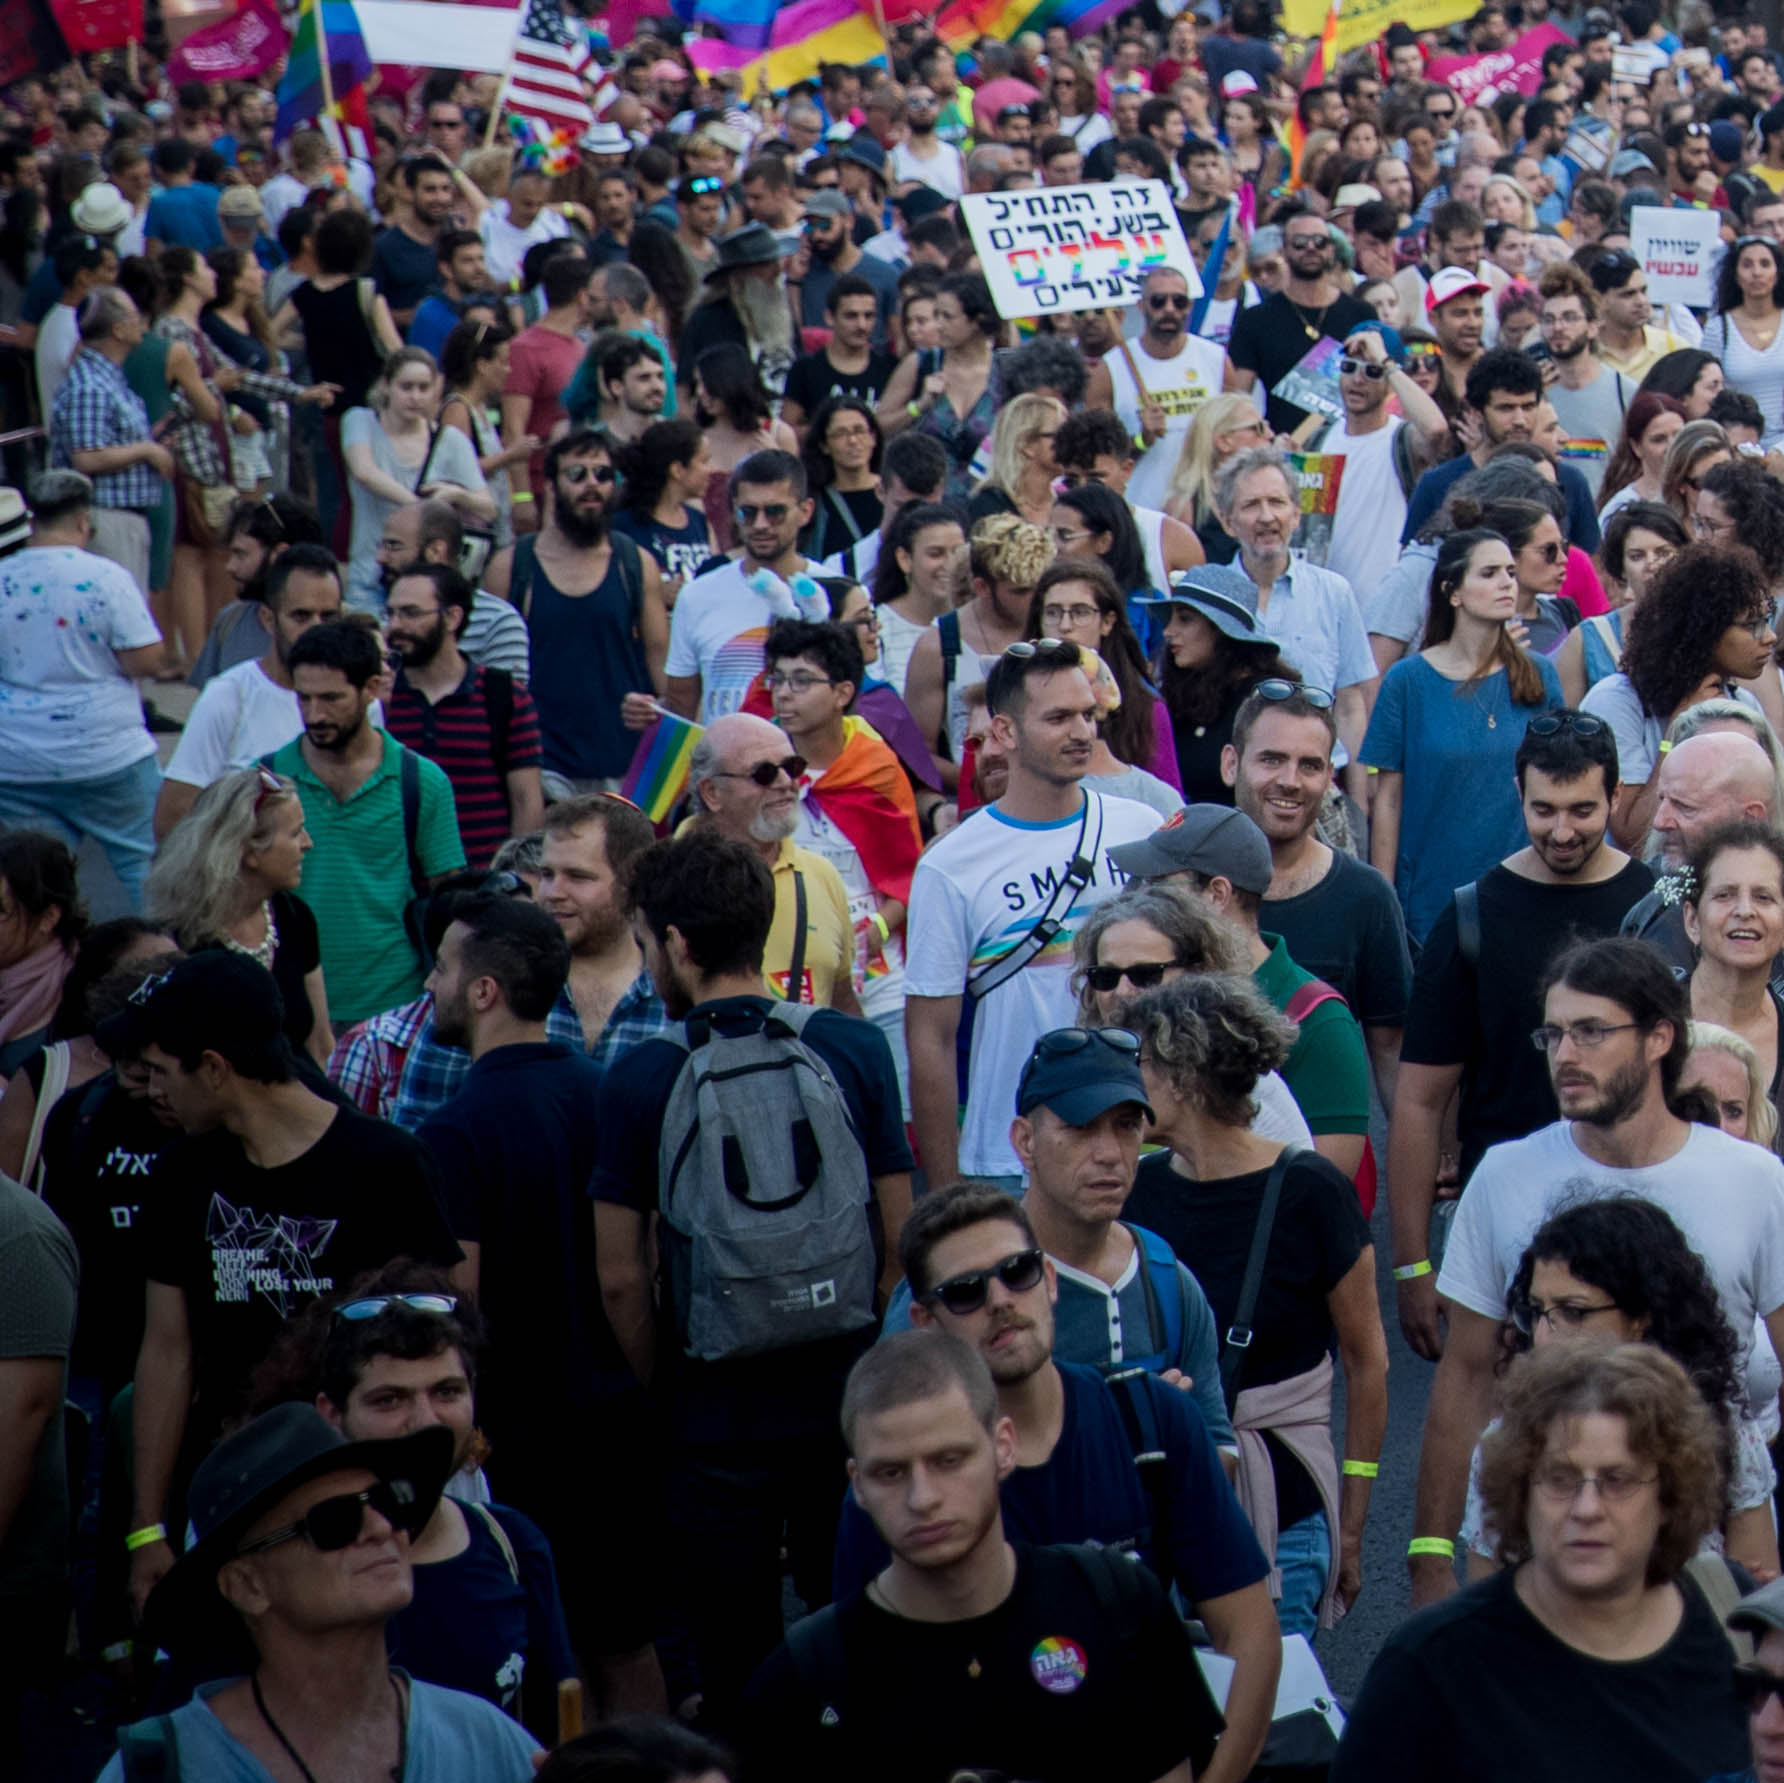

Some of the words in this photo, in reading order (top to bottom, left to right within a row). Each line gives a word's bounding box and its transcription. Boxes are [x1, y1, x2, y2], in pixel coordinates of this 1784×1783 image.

[986, 192, 1096, 221] התחיל
[1111, 187, 1151, 209] זה
[989, 220, 1087, 250] הורים
[1094, 212, 1171, 236] בשני
[1006, 231, 1168, 287] עליזים
[1648, 237, 1701, 259] שוויון
[1645, 260, 1699, 277] עכשיו
[255, 1279, 291, 1293] LOSE
[293, 1277, 334, 1292] YOUR
[1035, 1646, 1079, 1674] גאה
